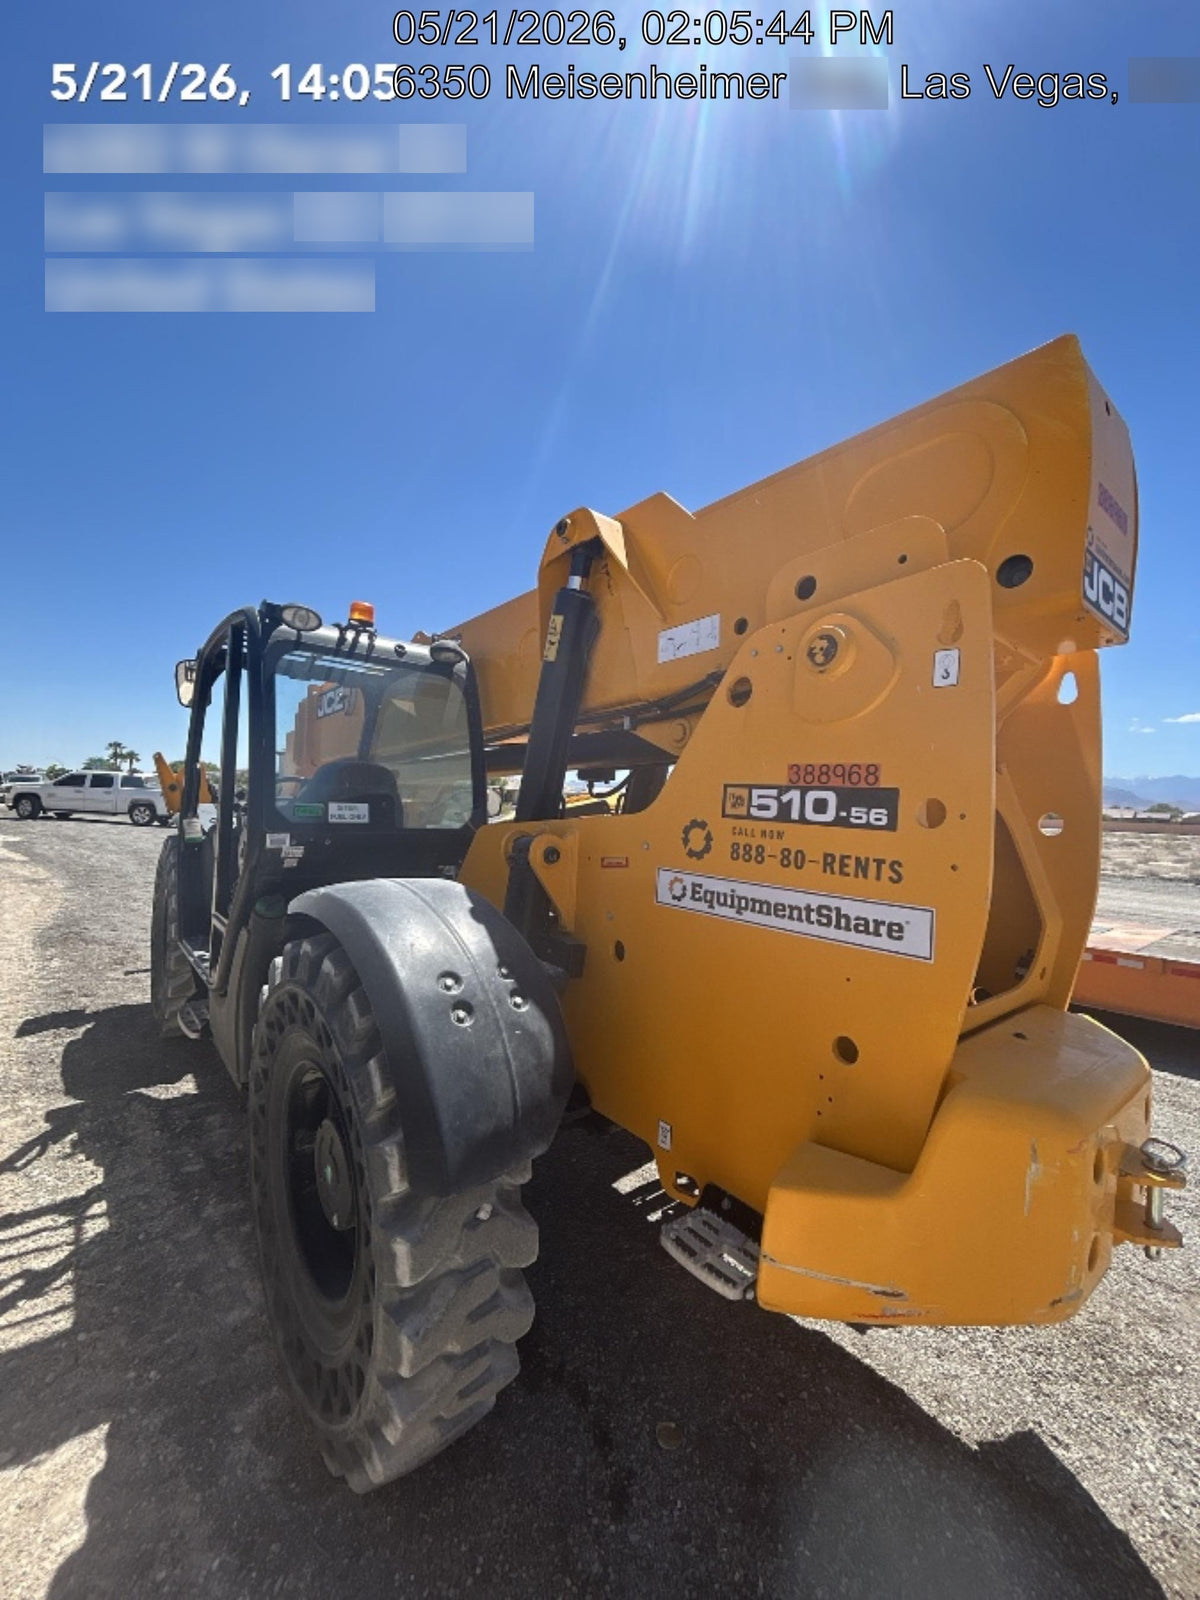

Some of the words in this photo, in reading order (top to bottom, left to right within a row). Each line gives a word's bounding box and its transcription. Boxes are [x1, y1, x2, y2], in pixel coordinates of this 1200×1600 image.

[1084, 561, 1128, 629] JCB
[788, 763, 880, 787] 388968
[731, 826, 756, 838] CALL
[760, 829, 785, 840] NOW
[730, 842, 904, 885] 888-80-RENTS
[690, 882, 904, 941] EquipmentShare
